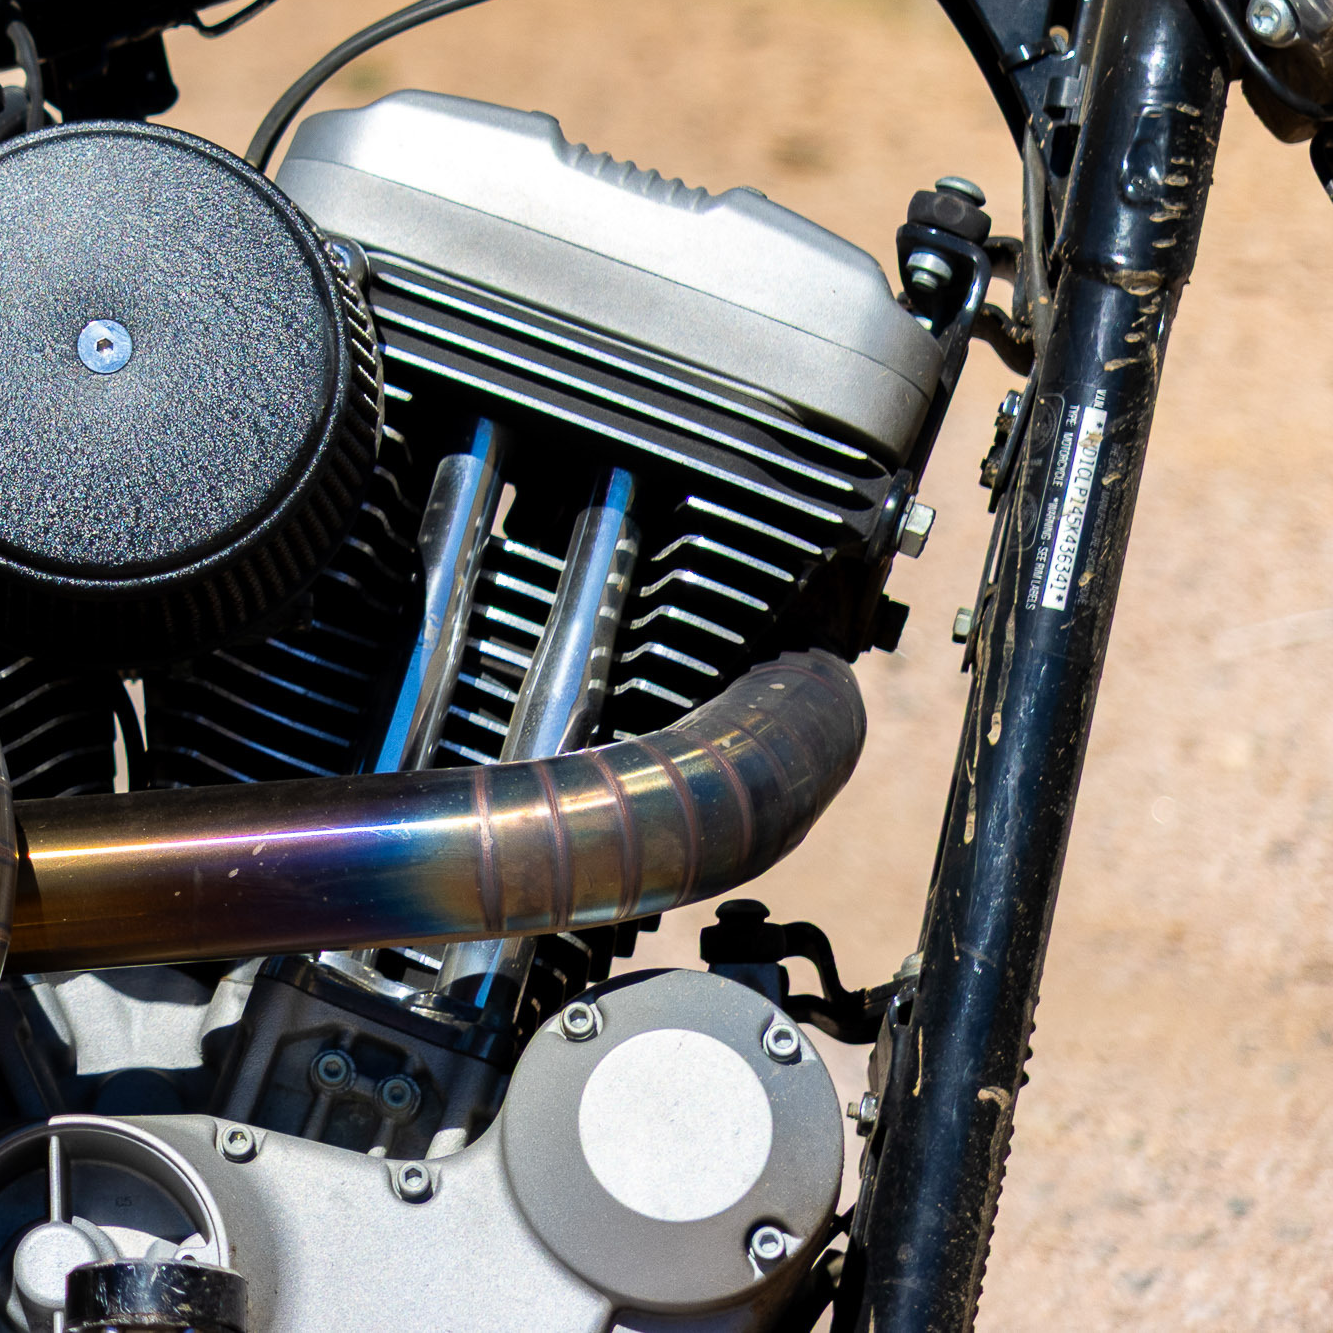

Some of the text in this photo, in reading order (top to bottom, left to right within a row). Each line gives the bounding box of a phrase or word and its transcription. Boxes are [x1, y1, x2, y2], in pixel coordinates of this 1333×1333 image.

[1052, 431, 1074, 488] MOTORCYCLE
[1034, 544, 1049, 563] SEE
[1024, 578, 1042, 611] LABELS
